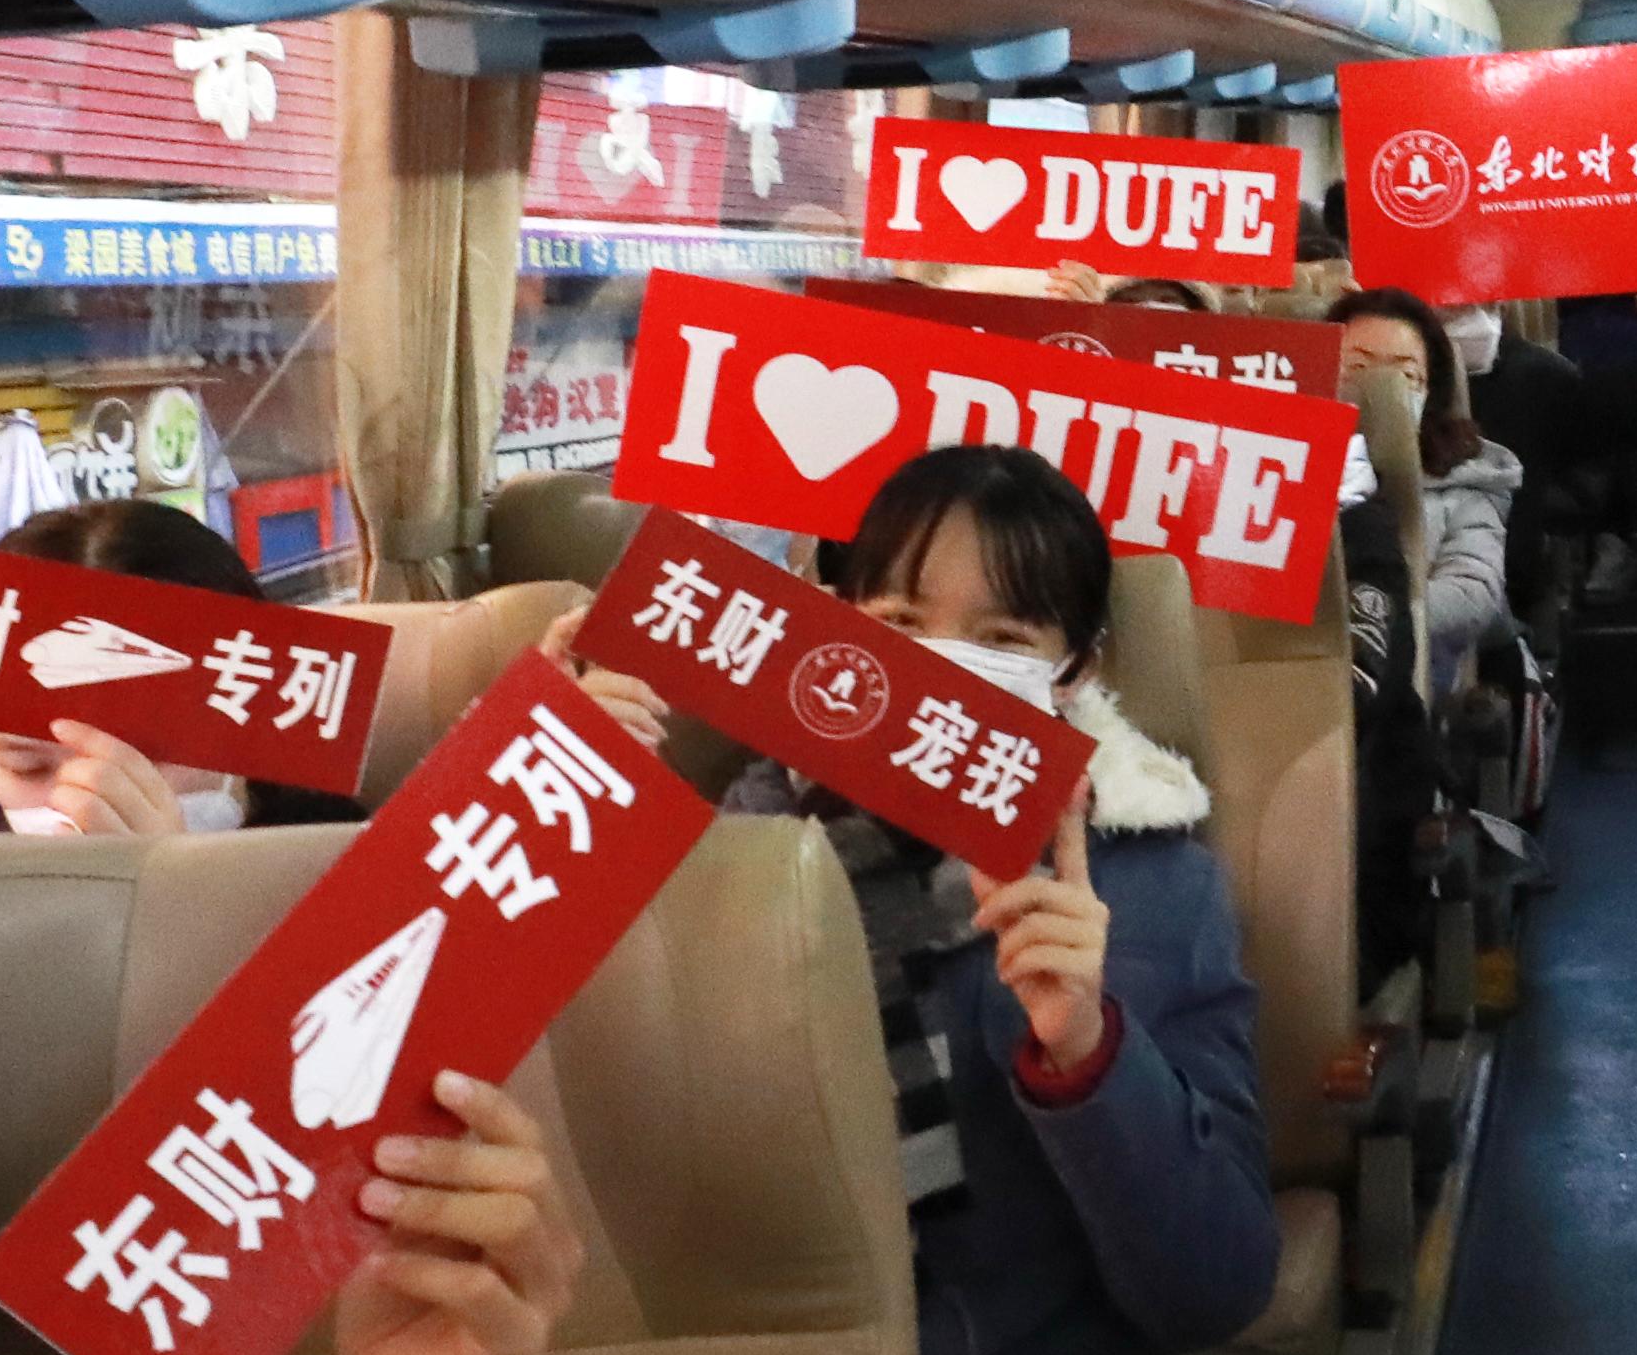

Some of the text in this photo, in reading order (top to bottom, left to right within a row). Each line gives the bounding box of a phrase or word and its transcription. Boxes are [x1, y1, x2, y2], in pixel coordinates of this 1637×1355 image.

[65, 229, 197, 278] 梁园美食城
[887, 146, 928, 232] I
[1036, 155, 1277, 256] DUFE
[659, 324, 737, 468] I
[201, 630, 357, 742] 专列
[633, 557, 1043, 828] 东财 宠我
[63, 702, 636, 1353] 东财 专列
